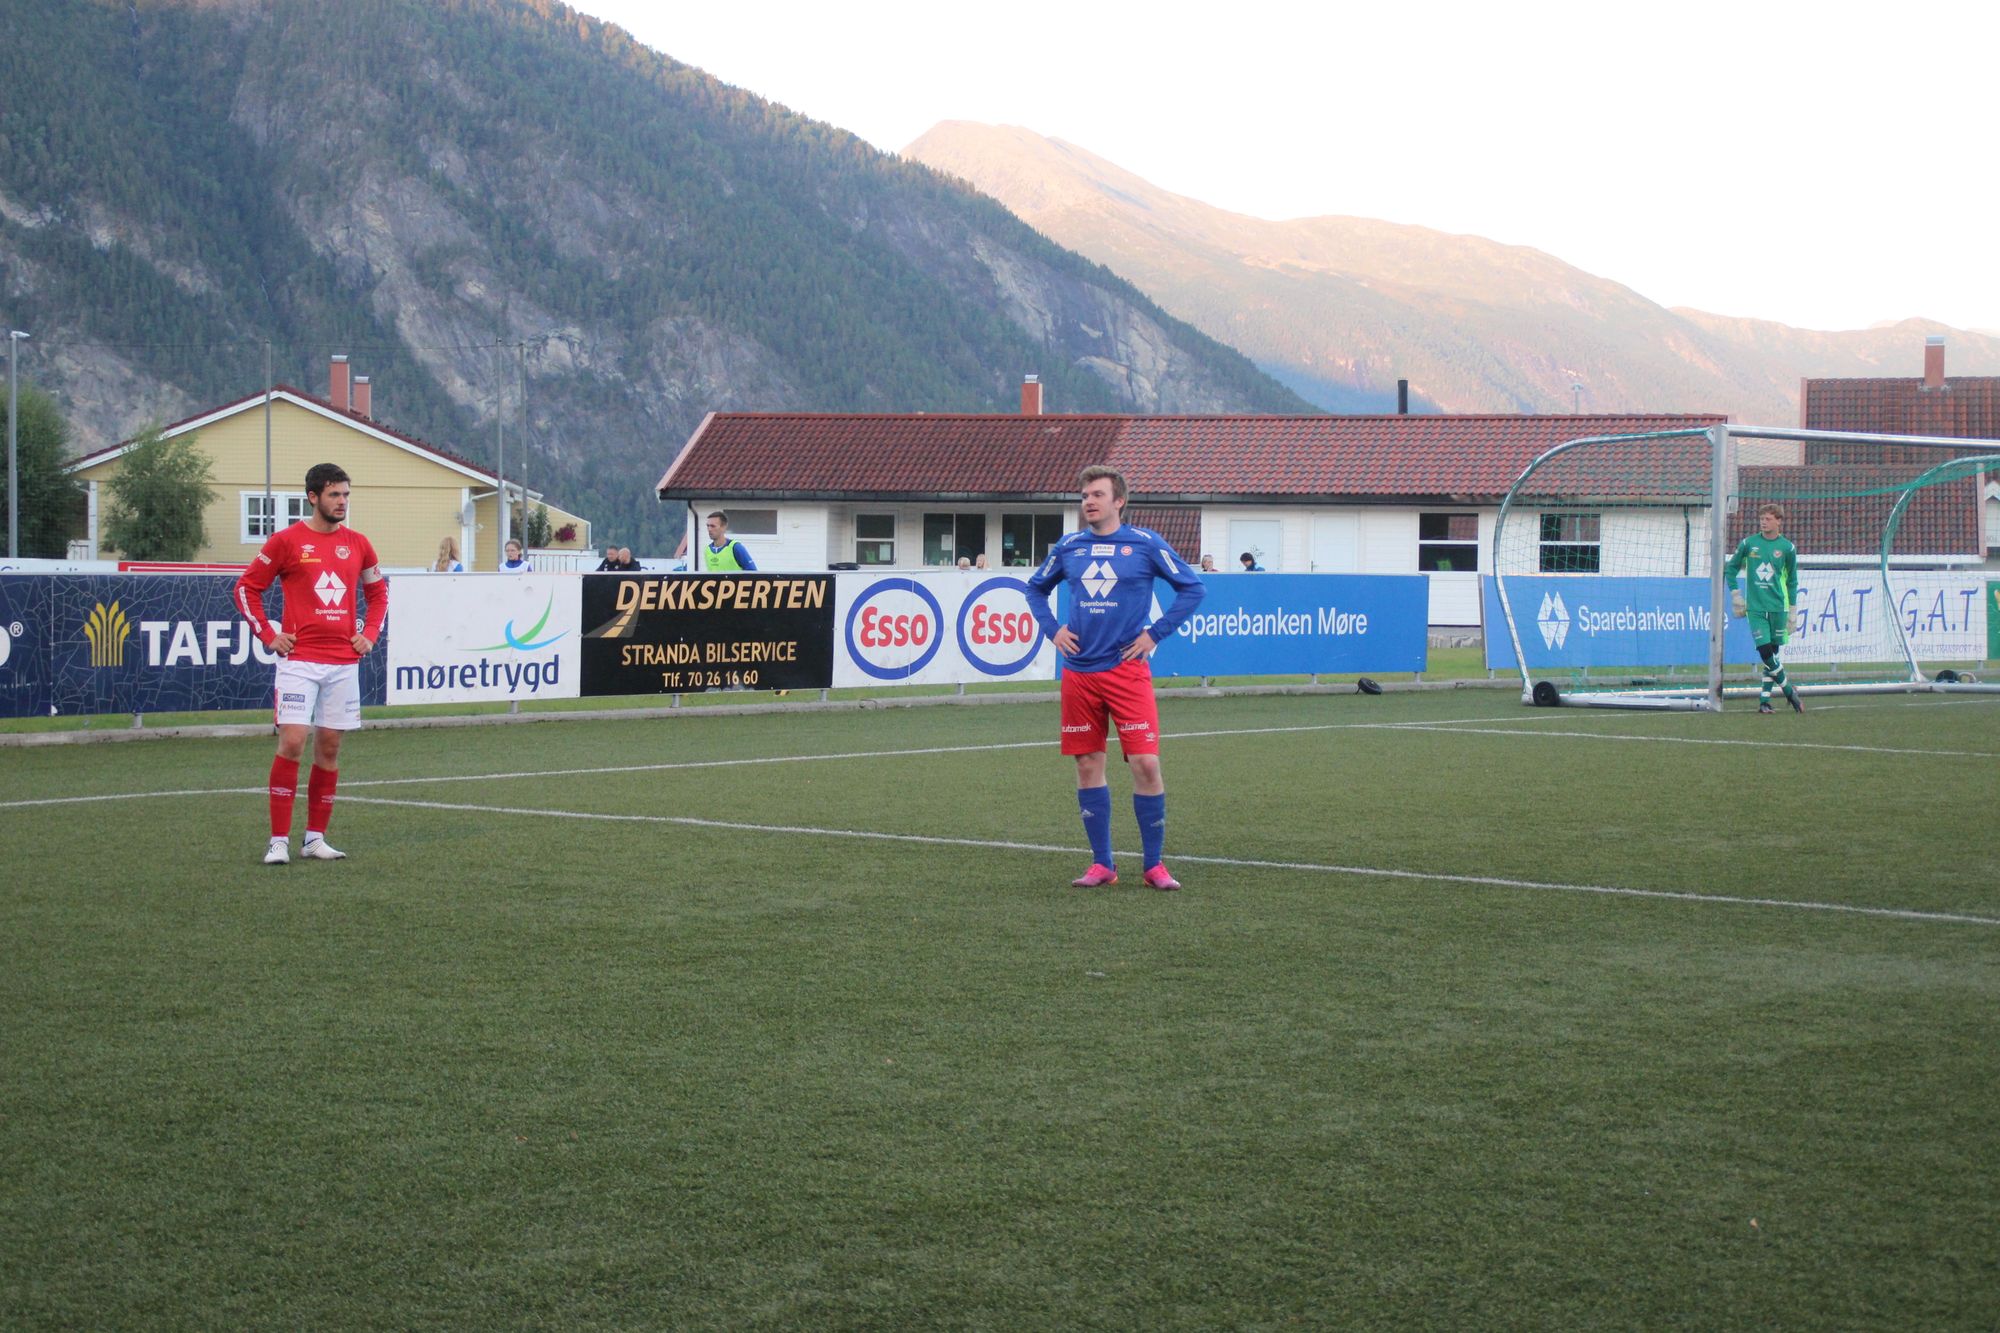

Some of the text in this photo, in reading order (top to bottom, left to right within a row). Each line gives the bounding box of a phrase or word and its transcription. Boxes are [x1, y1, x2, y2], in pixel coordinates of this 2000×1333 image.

[615, 580, 827, 611] DEKKSPERTEN
[1318, 606, 1368, 636] Møre
[1578, 605, 1729, 637] Sparebanken Møe
[1796, 586, 1873, 639] G.A.T
[1900, 586, 1979, 639] G.A.T
[140, 620, 282, 667] TAFJO
[621, 641, 798, 666] STRANDA BILSERVICE
[396, 654, 559, 693] møretrygd
[662, 670, 758, 687] Tlf. 70 26 16 60
